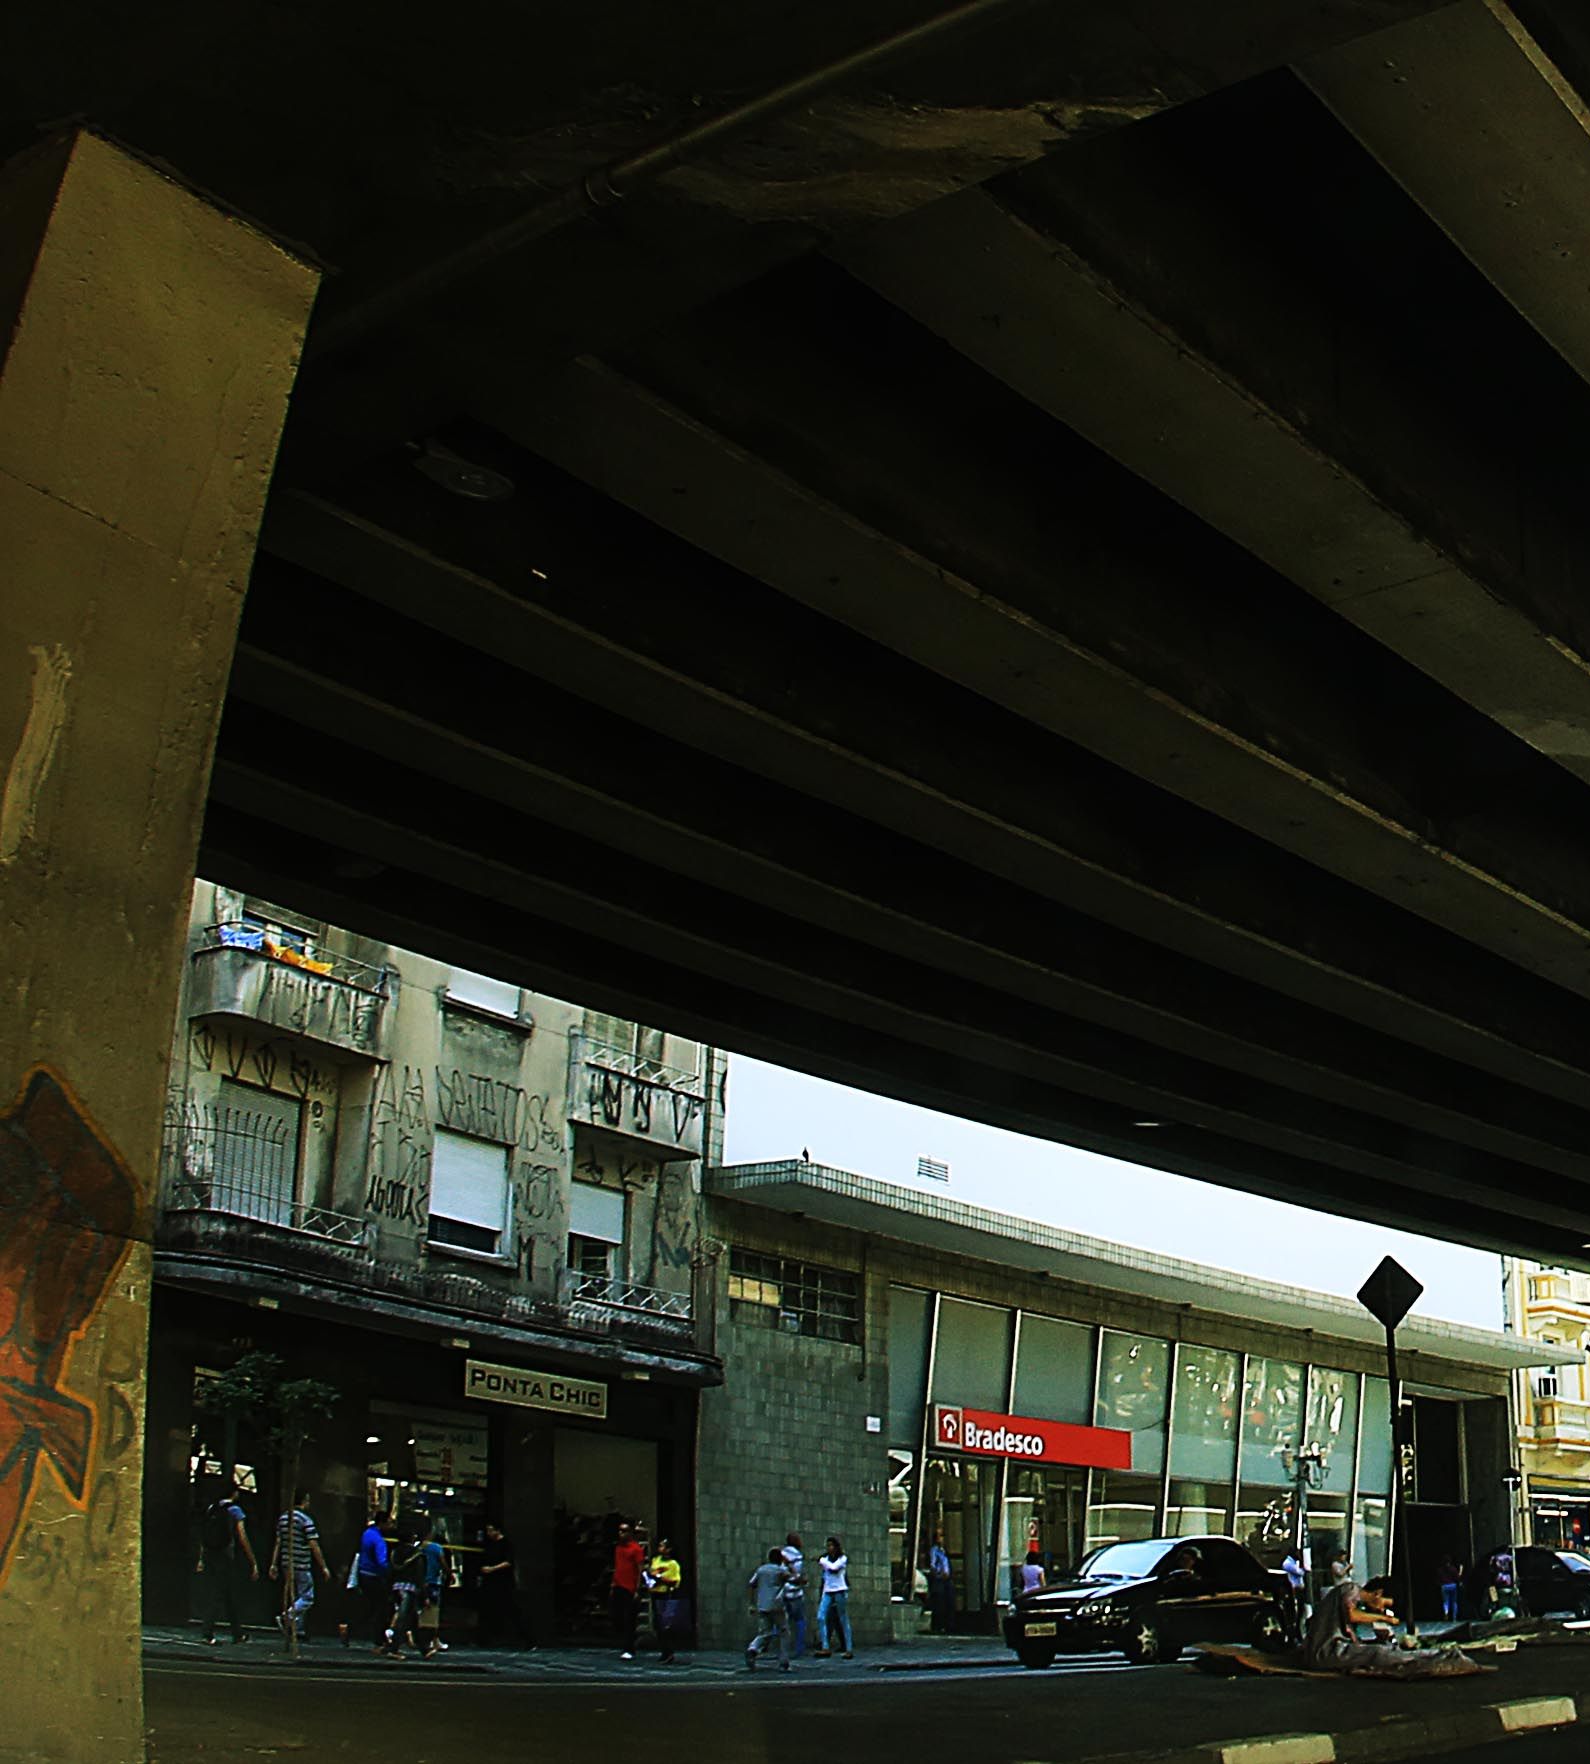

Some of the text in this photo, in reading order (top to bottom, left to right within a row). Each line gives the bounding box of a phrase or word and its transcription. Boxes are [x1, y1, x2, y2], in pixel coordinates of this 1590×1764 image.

[471, 1368, 601, 1407] PONTA CHIC
[965, 1421, 1043, 1456] Bradesco
